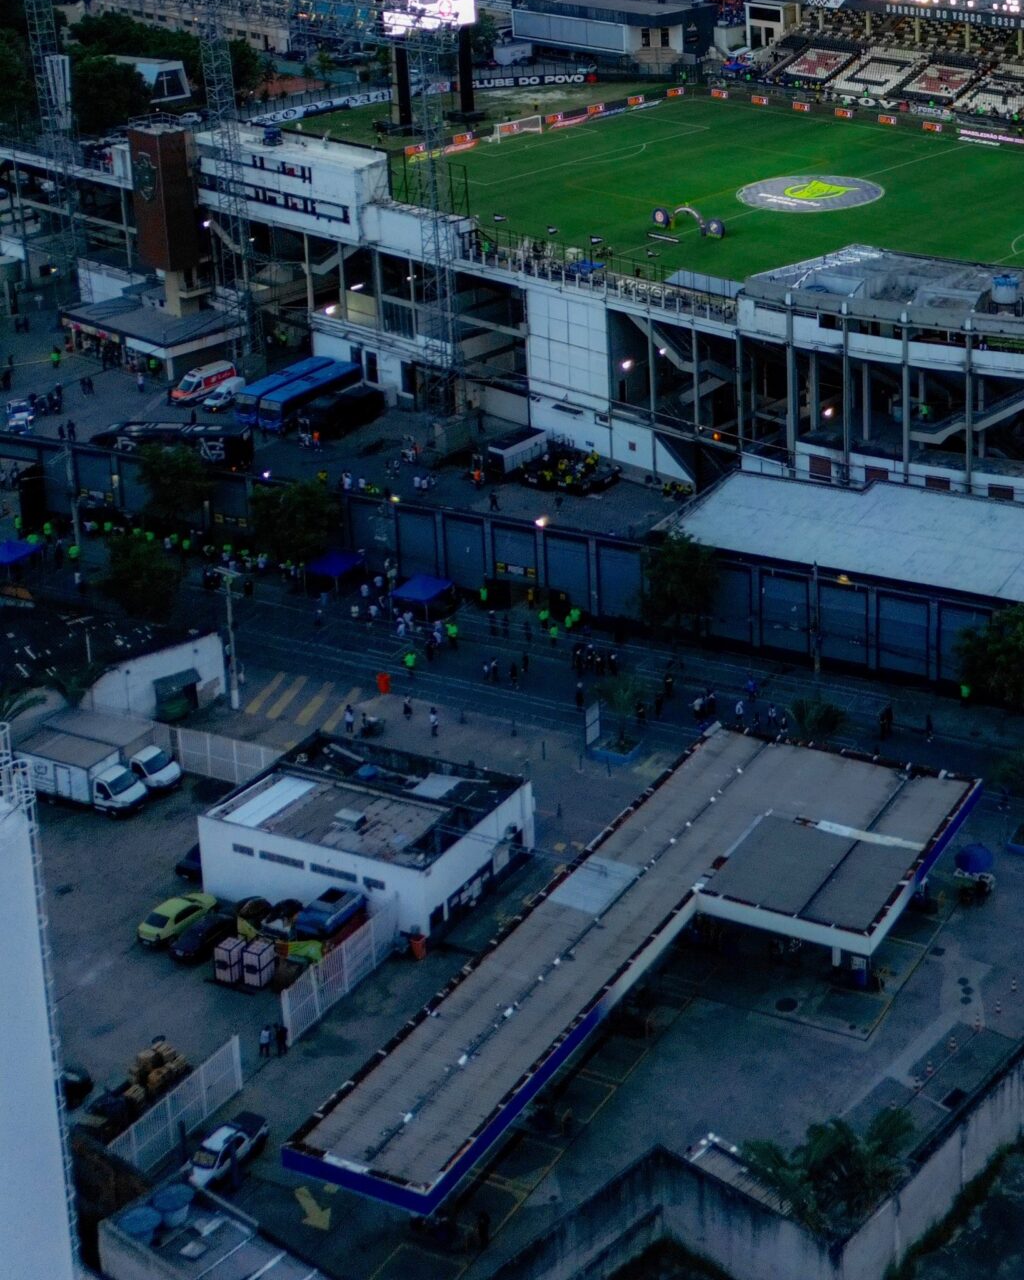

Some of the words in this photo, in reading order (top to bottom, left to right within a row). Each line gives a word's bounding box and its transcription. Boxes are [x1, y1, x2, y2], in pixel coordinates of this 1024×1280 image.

[885, 4, 931, 18] BARREIRA
[935, 9, 948, 19] DO
[991, 17, 1015, 27] CASA
[518, 76, 540, 86] DO
[544, 74, 585, 84] POVO
